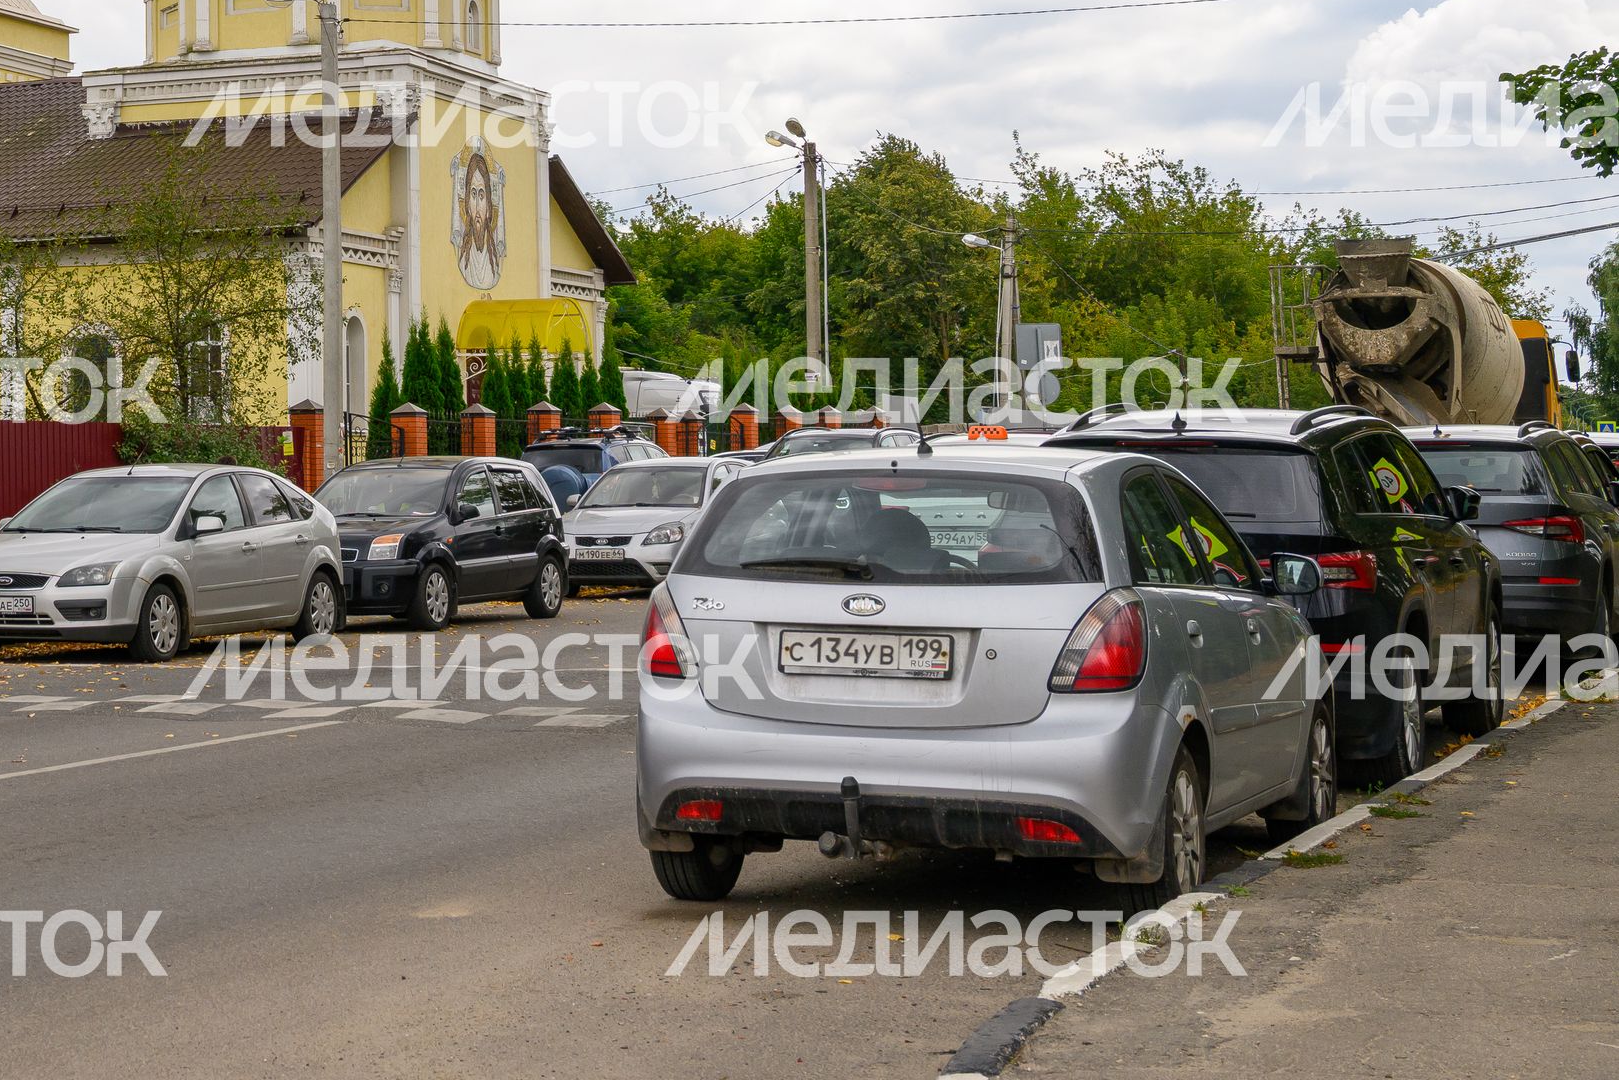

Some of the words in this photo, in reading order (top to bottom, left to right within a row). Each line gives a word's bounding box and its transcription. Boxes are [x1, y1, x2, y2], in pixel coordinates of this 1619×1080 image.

[578, 550, 611, 559] М190ЕЕ
[612, 549, 621, 557] 64
[14, 598, 30, 608] 250
[693, 597, 725, 610] Rio
[849, 597, 879, 611] KIA
[789, 637, 895, 666] С134УВ
[902, 638, 943, 659] 199
[910, 660, 931, 668] RUS
